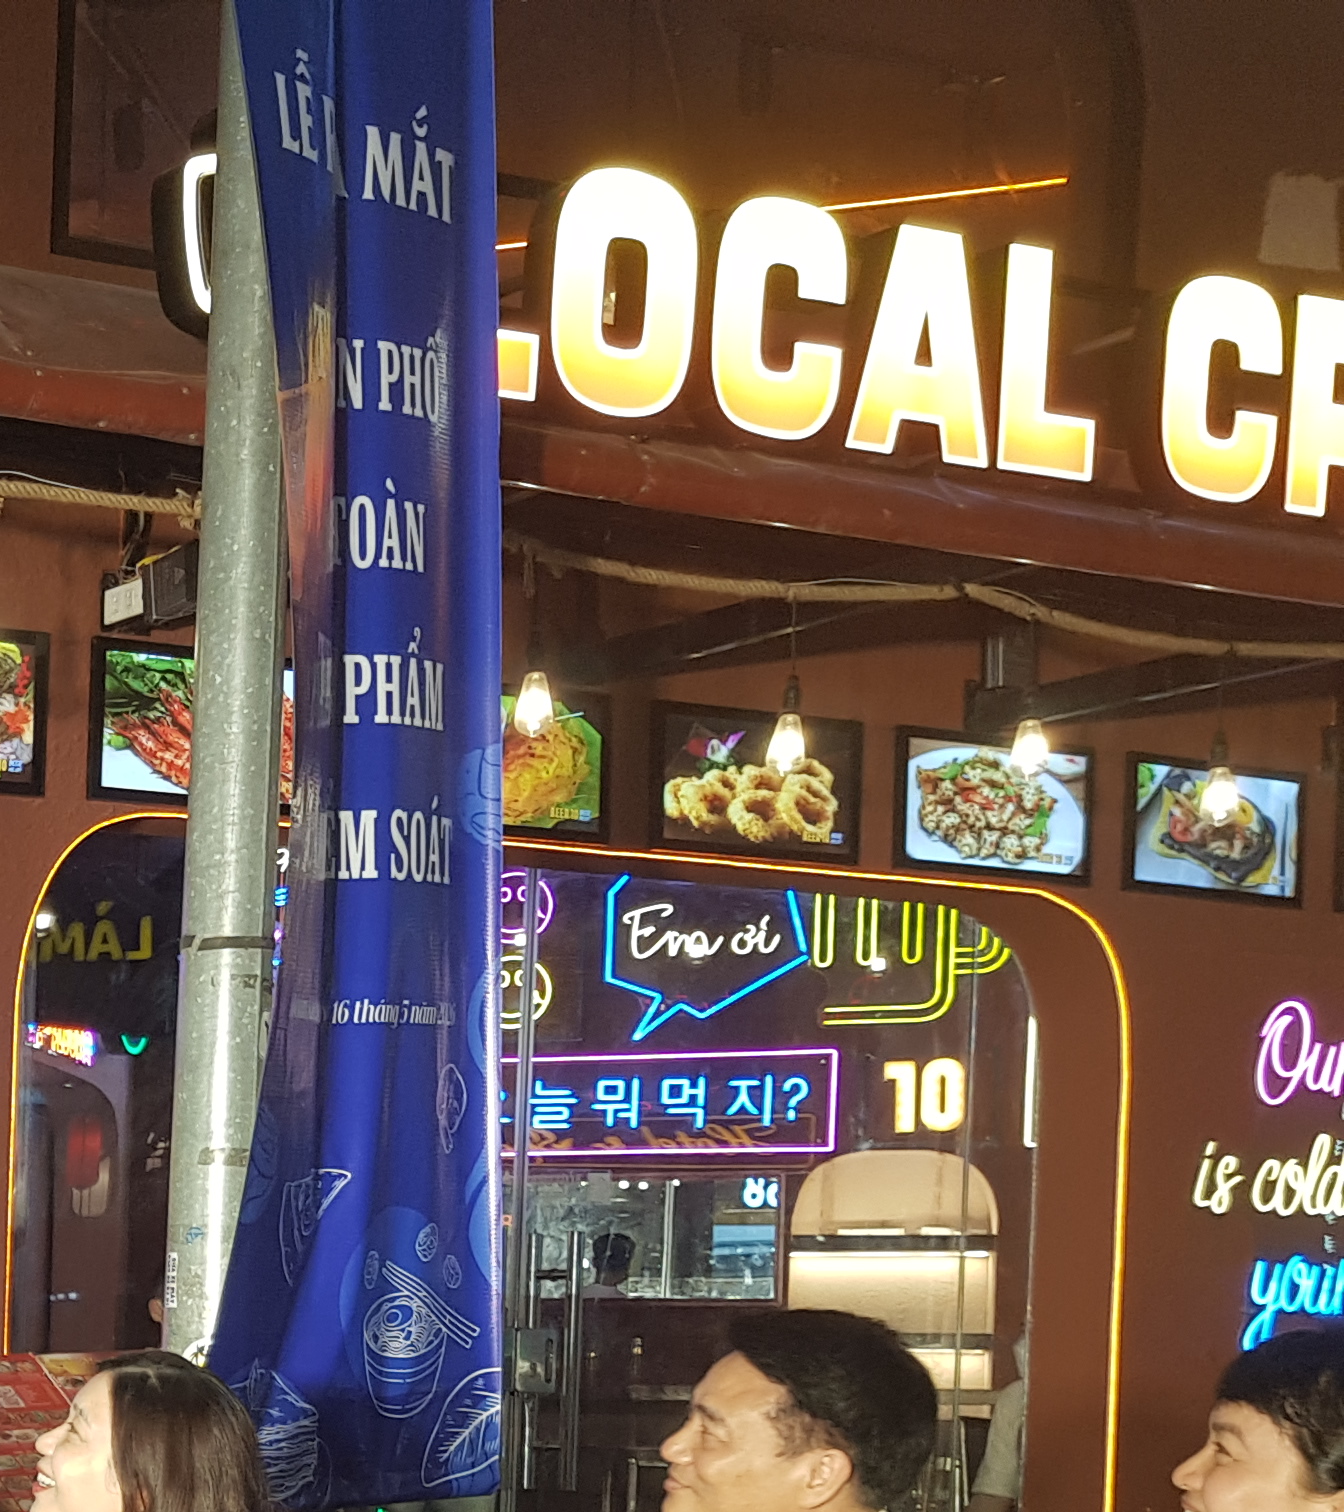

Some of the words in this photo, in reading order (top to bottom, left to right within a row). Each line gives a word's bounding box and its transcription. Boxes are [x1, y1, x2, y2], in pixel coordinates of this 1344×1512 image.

[362, 104, 456, 225] MẮT
[496, 166, 1097, 482] OCAL
[342, 627, 444, 732] PHẨM
[390, 795, 454, 886] SOÁT
[331, 999, 351, 1025] 16
[353, 998, 400, 1029] tháng
[399, 999, 411, 1025] 5
[883, 1057, 966, 1134] 10
[1192, 1140, 1245, 1216] is
